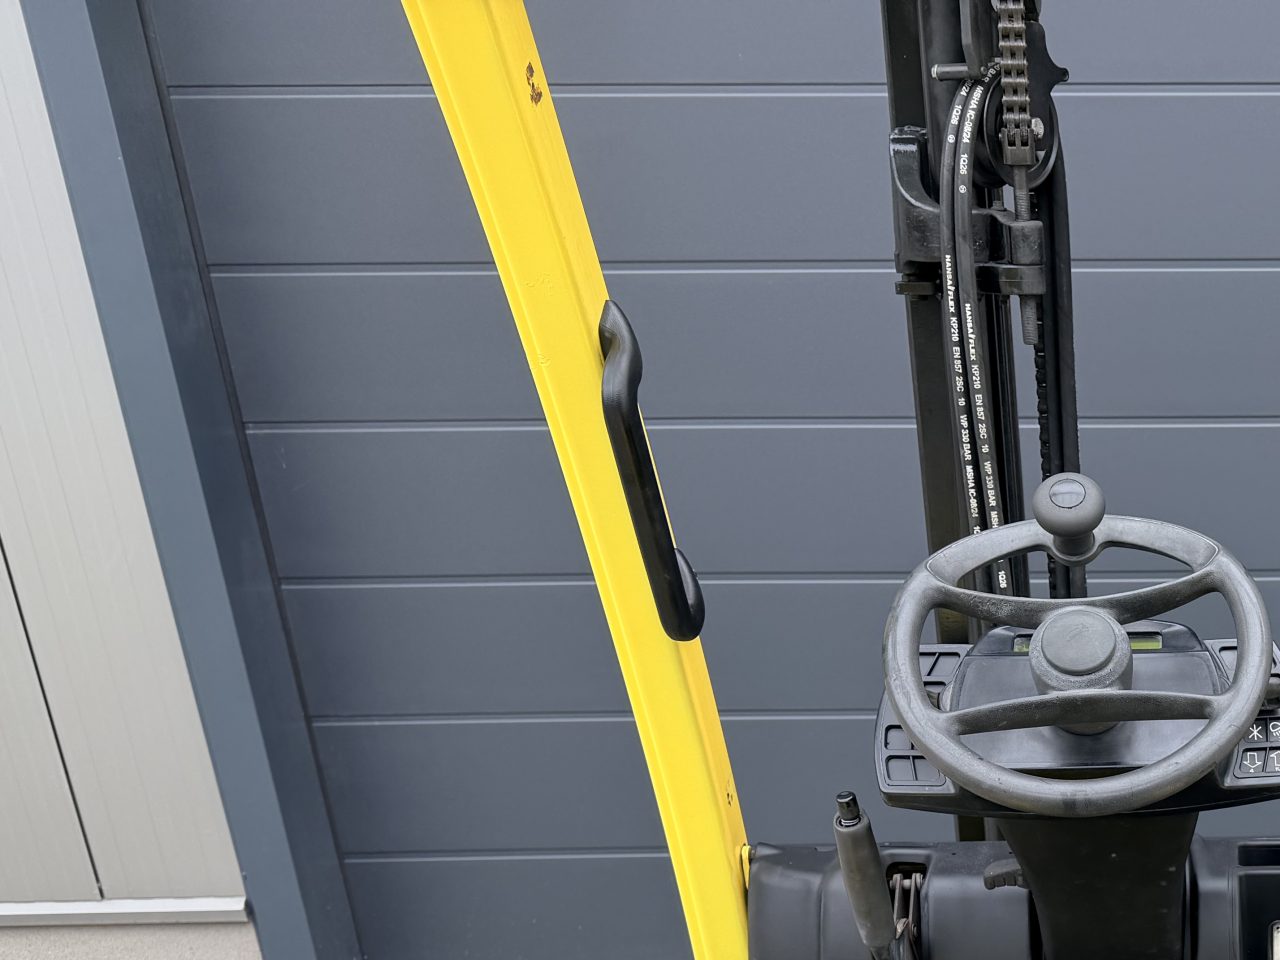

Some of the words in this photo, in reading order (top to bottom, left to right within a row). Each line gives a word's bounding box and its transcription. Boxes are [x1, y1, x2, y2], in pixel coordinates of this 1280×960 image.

[969, 85, 984, 109] MSHA
[960, 153, 968, 175] 1Q26
[950, 317, 960, 342] KP210
[953, 346, 961, 359] EN
[954, 359, 962, 373] 857
[956, 376, 964, 392] 2SC
[971, 364, 981, 389] KP210
[958, 397, 966, 406] 10
[975, 394, 983, 406] EN
[960, 414, 968, 429] WP
[976, 406, 985, 421] 857
[961, 429, 970, 443] 330
[978, 423, 987, 439] 2SC
[963, 443, 972, 461] BAR
[981, 444, 989, 453] 10
[984, 461, 992, 475] WP
[965, 465, 975, 488] MSHA
[986, 475, 994, 489] 330
[988, 489, 997, 507] BAR
[991, 511, 999, 528] MSH
[998, 568, 1007, 589] 1Q26
